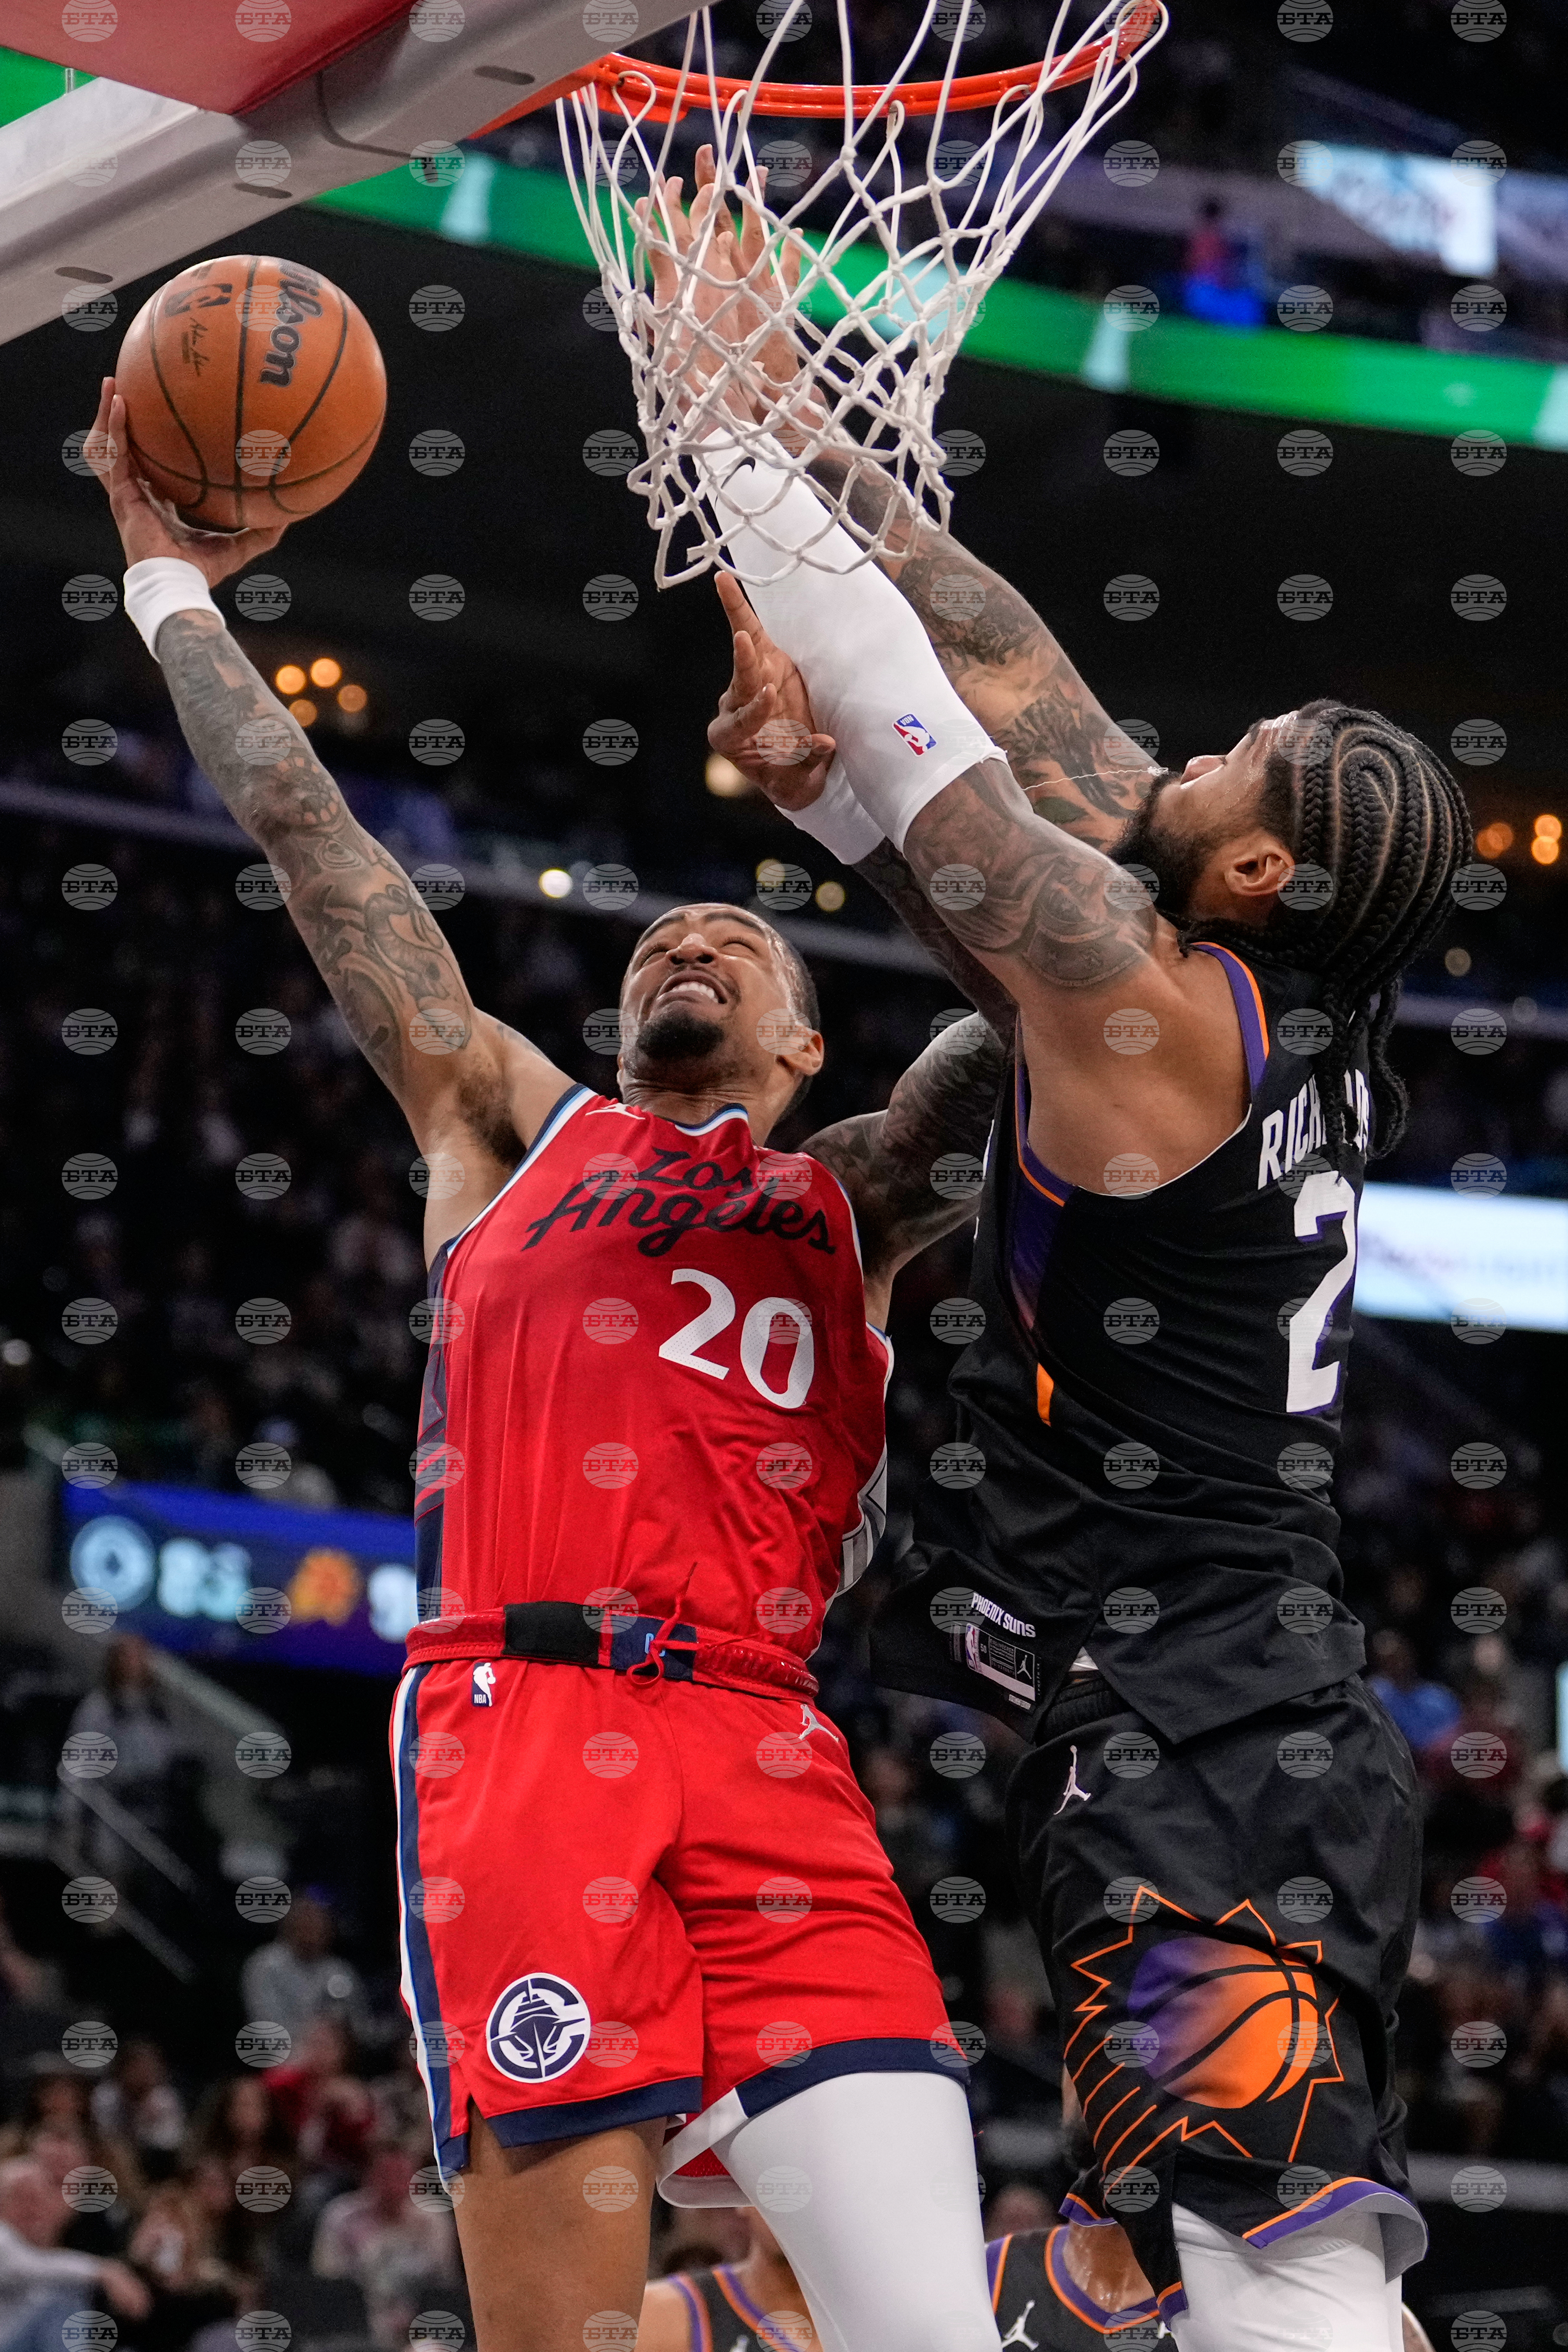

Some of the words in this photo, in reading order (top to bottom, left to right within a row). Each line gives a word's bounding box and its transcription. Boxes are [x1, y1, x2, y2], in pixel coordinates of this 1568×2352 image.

[900, 715, 914, 726] NBA
[631, 1147, 756, 1197] Los
[521, 1170, 835, 1257] Angeles
[1286, 1170, 1356, 1414] 2
[658, 1268, 814, 1409] 20
[971, 1592, 1005, 1626] PHOENIX
[474, 1694, 487, 1704] NBA
